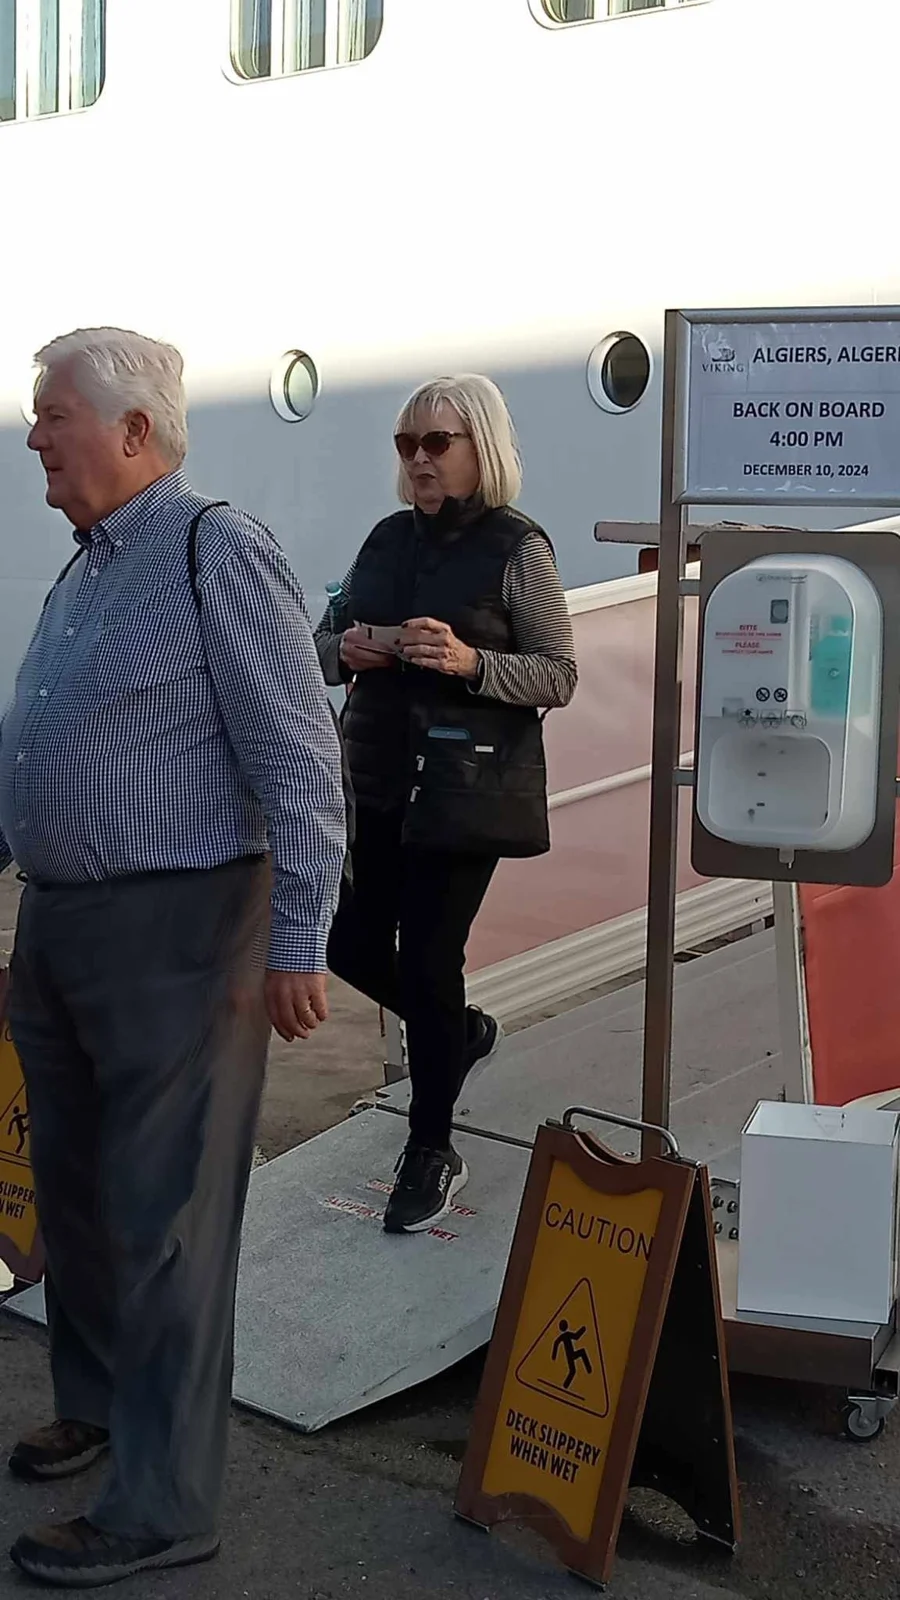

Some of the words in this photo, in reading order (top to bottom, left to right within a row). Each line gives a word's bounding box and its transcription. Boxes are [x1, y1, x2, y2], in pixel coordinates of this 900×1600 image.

[752, 346, 832, 366] ALGIERS,
[702, 363, 744, 373] VIKING
[733, 402, 780, 418] BACK
[785, 402, 813, 418] ON
[819, 402, 885, 418] BOARD
[769, 431, 809, 447] 4:00
[814, 431, 843, 447] PM
[743, 464, 812, 476] DECEMBER
[816, 464, 834, 478] 10,
[838, 464, 869, 477] 2024
[6, 1200, 25, 1220] WET
[451, 1204, 477, 1217] TEP
[427, 1226, 459, 1241] WET
[545, 1202, 653, 1261] CAUTION
[506, 1408, 538, 1437] DECK
[539, 1423, 601, 1467] SLIPPERY
[509, 1434, 549, 1472] WHEN
[549, 1452, 579, 1484] WET
